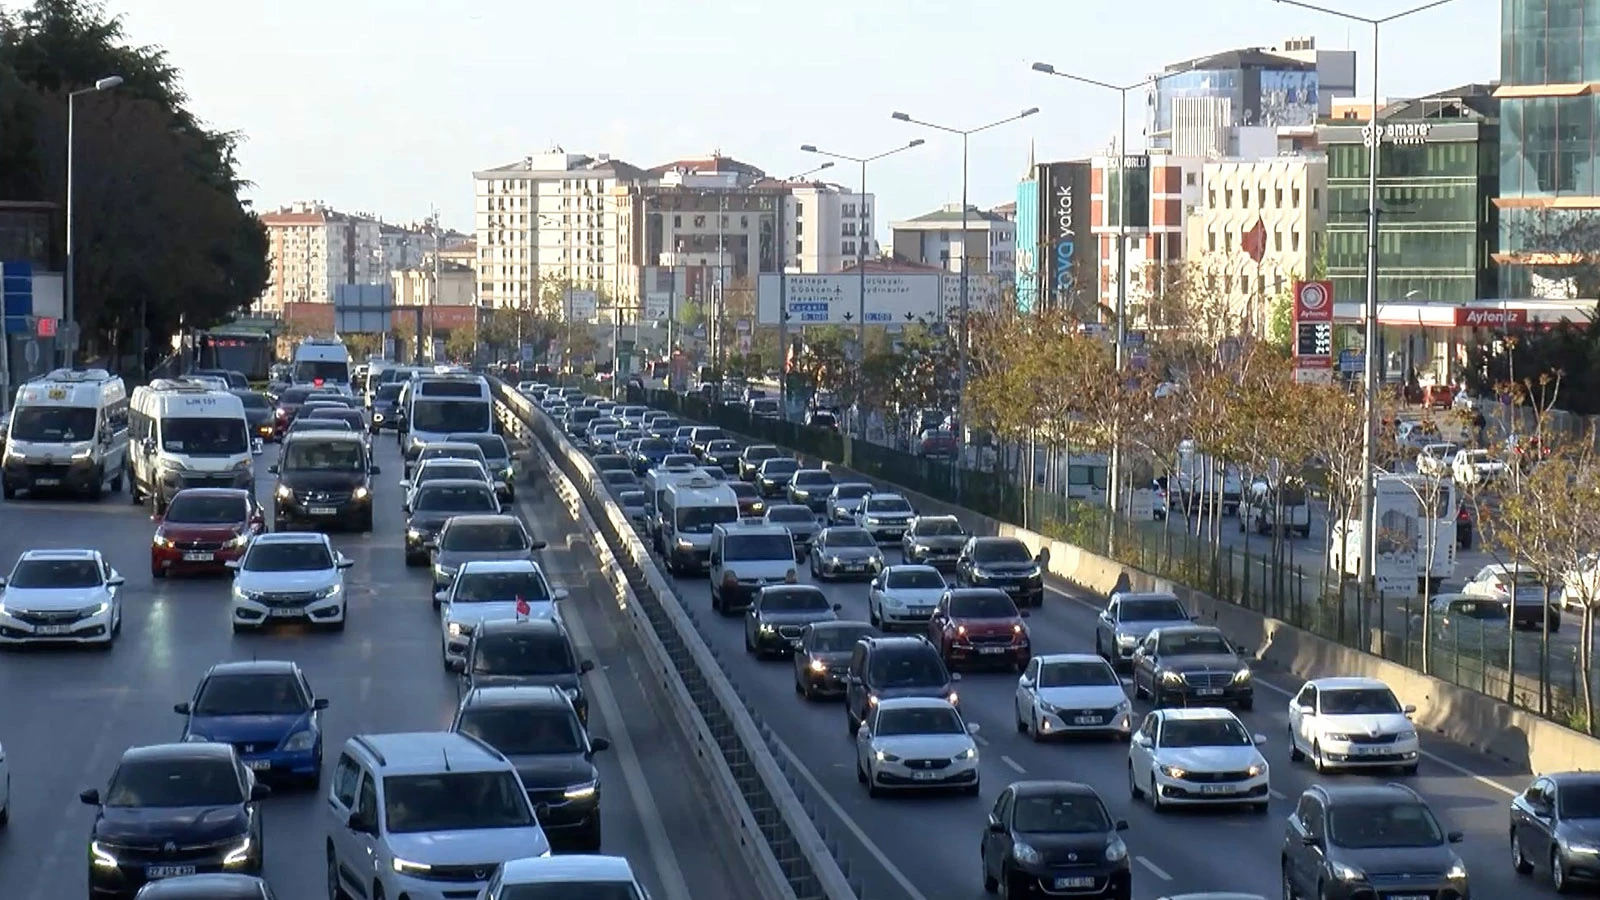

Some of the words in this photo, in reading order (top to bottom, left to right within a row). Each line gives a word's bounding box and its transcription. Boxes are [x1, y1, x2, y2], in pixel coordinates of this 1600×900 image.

[1387, 123, 1427, 137] amare
[1056, 185, 1075, 238] yatak
[790, 277, 828, 285] Maltepe
[863, 277, 904, 285] üçükyalı
